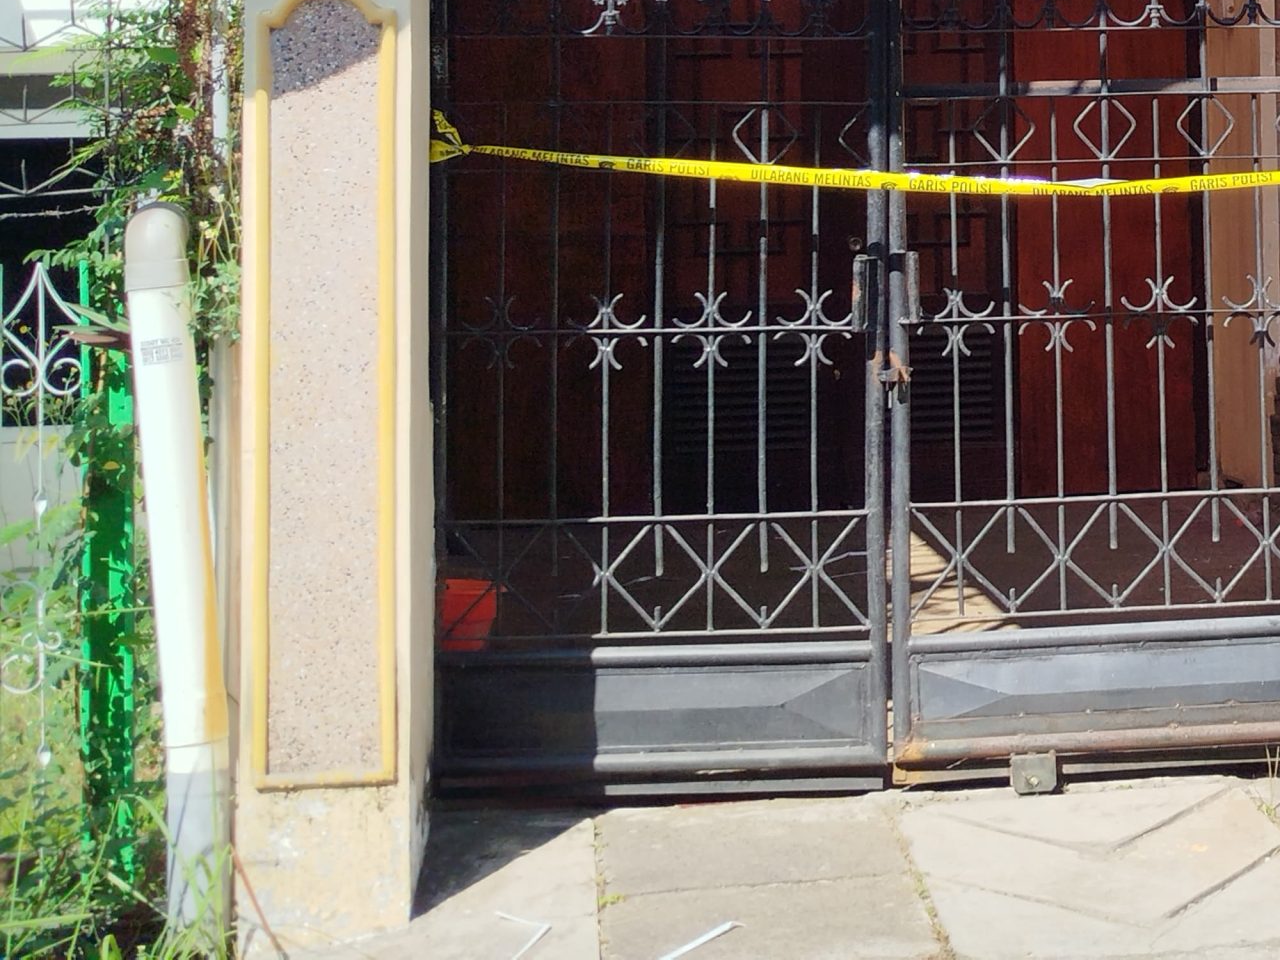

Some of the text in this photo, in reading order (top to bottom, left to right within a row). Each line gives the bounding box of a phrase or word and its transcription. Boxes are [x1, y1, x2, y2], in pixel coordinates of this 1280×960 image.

[625, 157, 711, 177] GARIS POLISI
[750, 168, 873, 188] DILARANG MELINTAS
[908, 178, 993, 194] GARIS POLISI
[1189, 172, 1274, 192] GARIS POLISI
